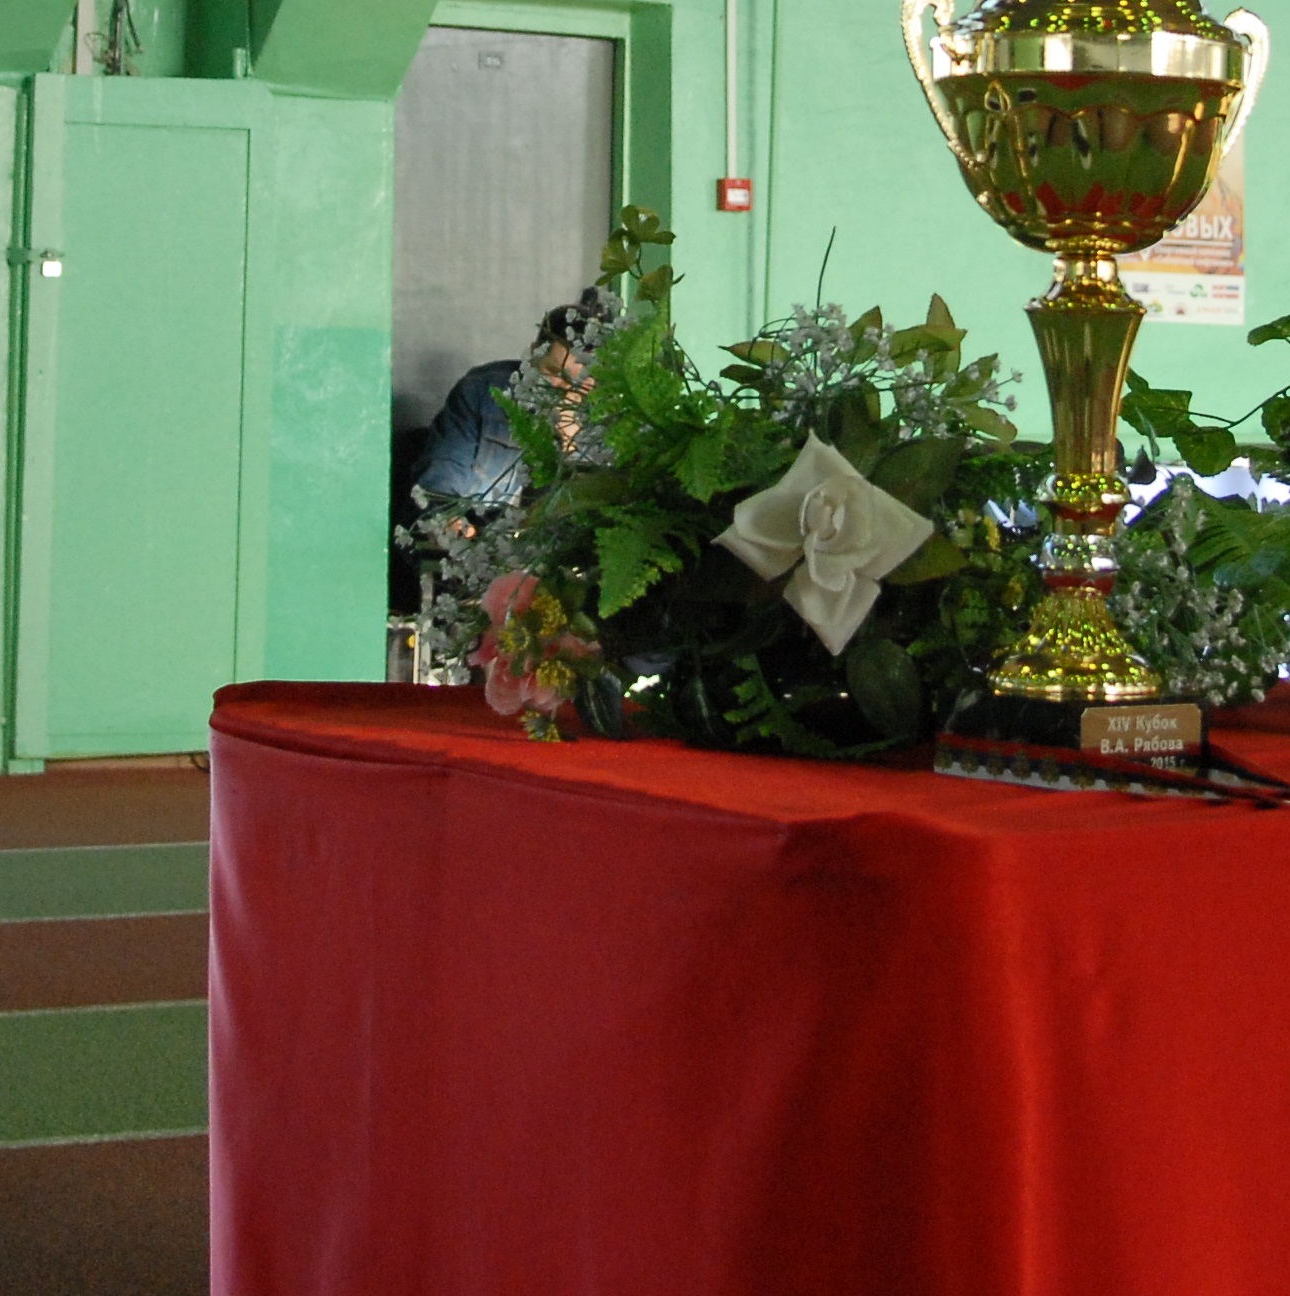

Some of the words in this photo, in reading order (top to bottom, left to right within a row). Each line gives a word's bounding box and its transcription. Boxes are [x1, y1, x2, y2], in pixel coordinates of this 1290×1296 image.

[1107, 715, 1131, 731] XIV
[1135, 713, 1178, 733] Кубок
[1100, 738, 1129, 754] В.А.
[1134, 735, 1184, 753] Рябова
[1150, 756, 1177, 770] 2015
